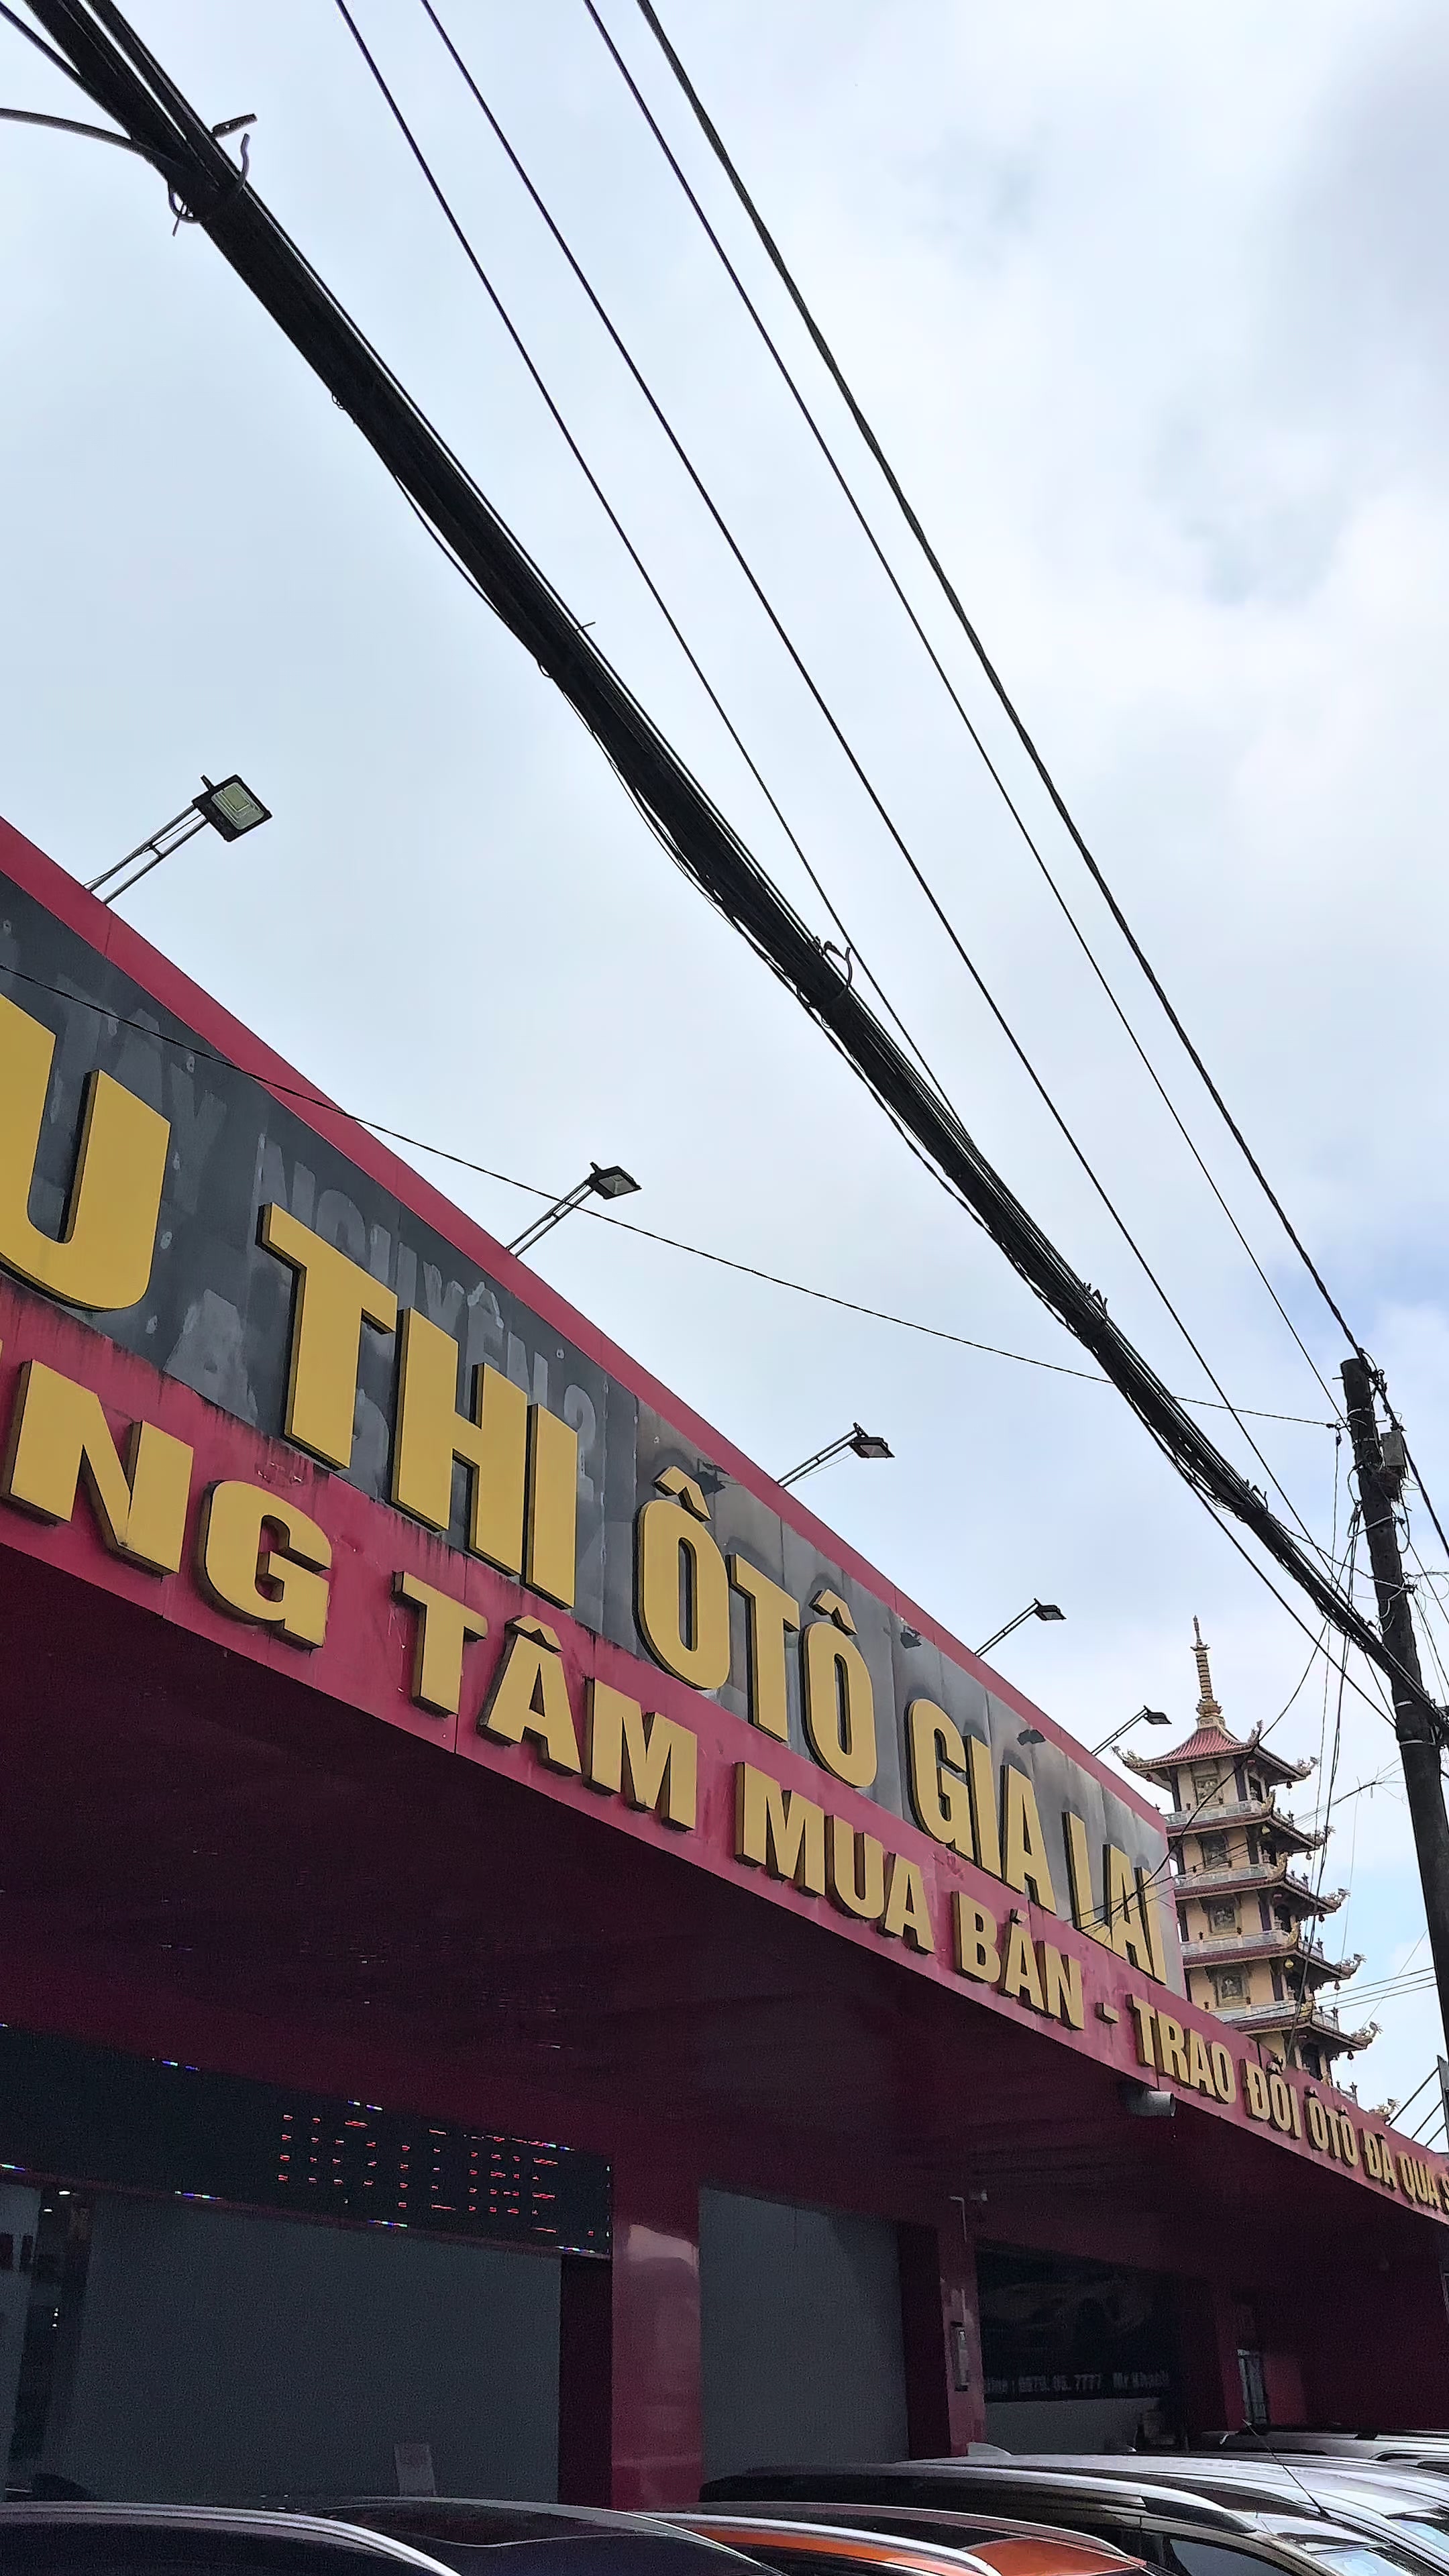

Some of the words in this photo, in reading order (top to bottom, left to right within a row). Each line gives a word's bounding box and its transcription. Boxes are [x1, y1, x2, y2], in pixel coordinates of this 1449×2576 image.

[0, 1339, 332, 1648] NG
[391, 1570, 697, 1831] TÂM
[735, 1762, 934, 1955] MUA
[951, 1890, 1084, 2031] BÁN
[1126, 1994, 1236, 2104] TRAO
[1303, 2086, 1358, 2168] ÔTÔ
[1395, 2151, 1442, 2210] QUA
[633, 1466, 877, 1788] ÔTÔ
[904, 1698, 1057, 1915] GIA
[1062, 1811, 1166, 1985] LAI
